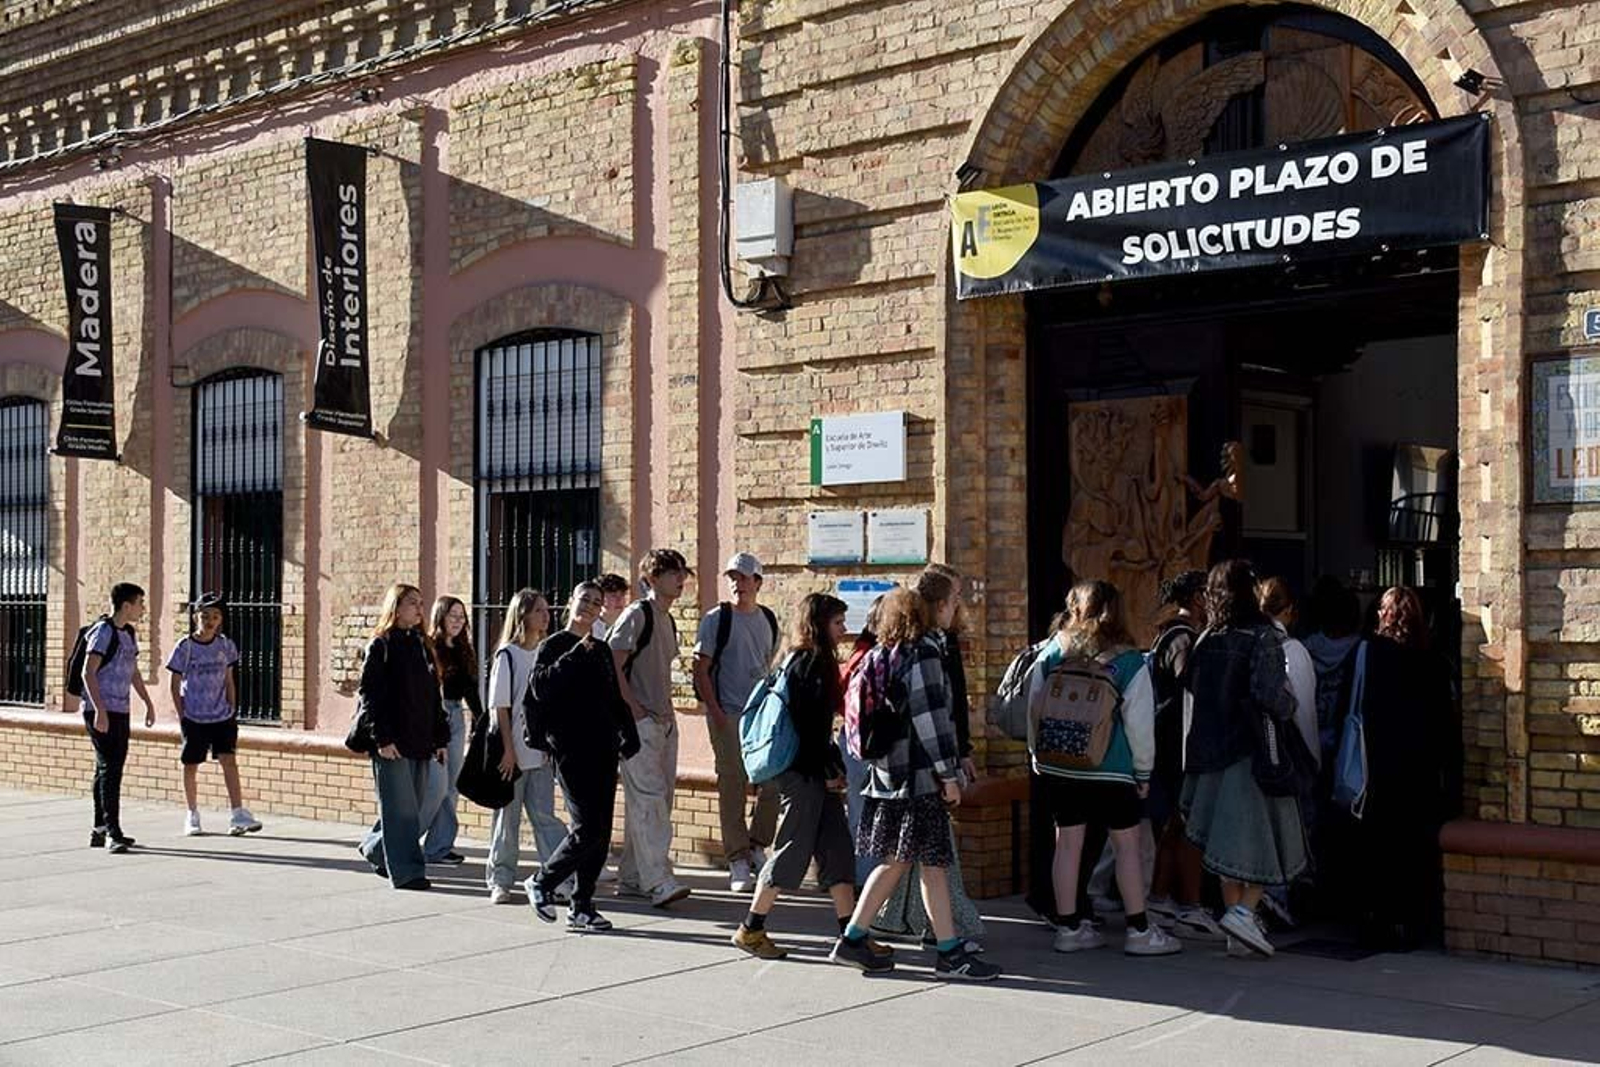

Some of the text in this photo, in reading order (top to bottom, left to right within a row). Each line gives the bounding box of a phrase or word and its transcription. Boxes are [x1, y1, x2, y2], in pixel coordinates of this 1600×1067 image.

[1066, 139, 1428, 221] ABIERTO PLAZO DE
[334, 184, 361, 368] Interiores
[1122, 207, 1362, 265] SOLICITUDES
[75, 222, 102, 376] Madera
[322, 256, 336, 367] Diseño de
